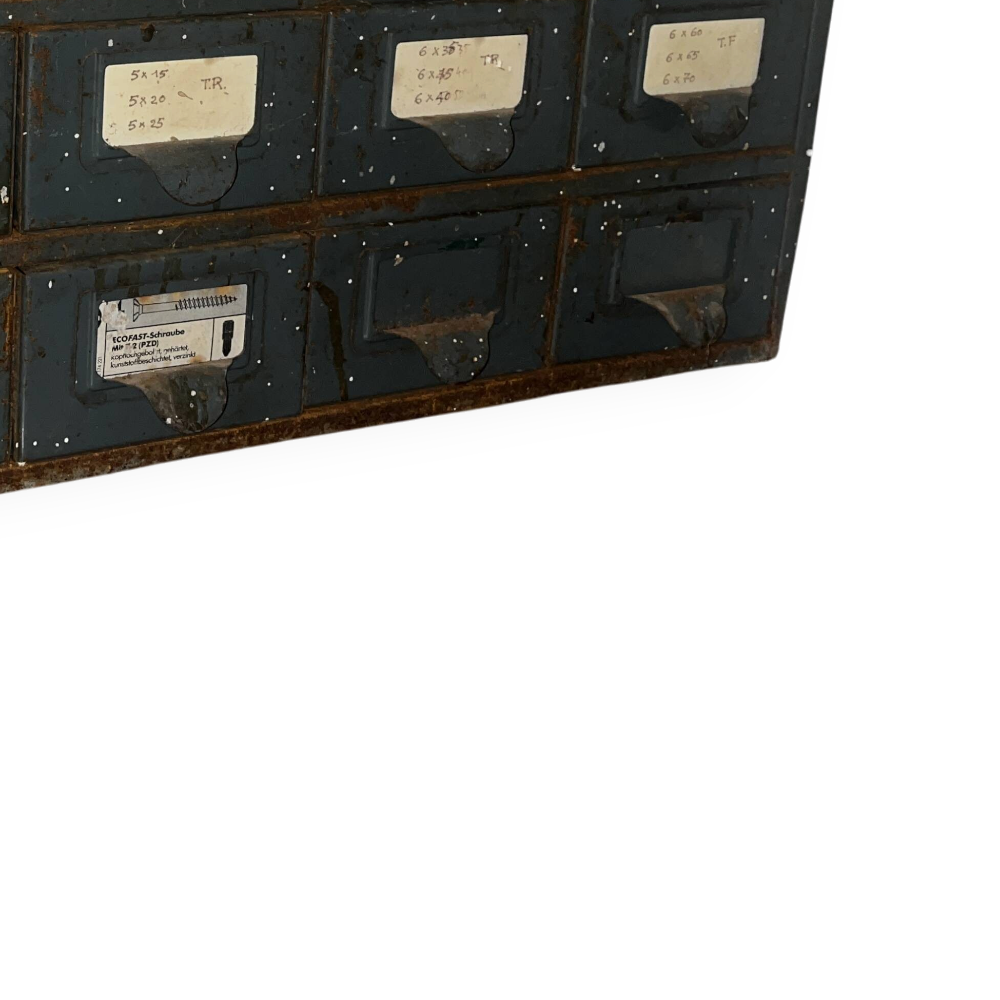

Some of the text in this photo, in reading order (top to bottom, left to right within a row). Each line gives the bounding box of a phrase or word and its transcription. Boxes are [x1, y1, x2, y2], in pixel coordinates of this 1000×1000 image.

[112, 329, 185, 343] ECOFAST-Schraube
[139, 340, 159, 350] (PZD)
[111, 351, 196, 368] kunststoffbeschichtet, verzinkt
